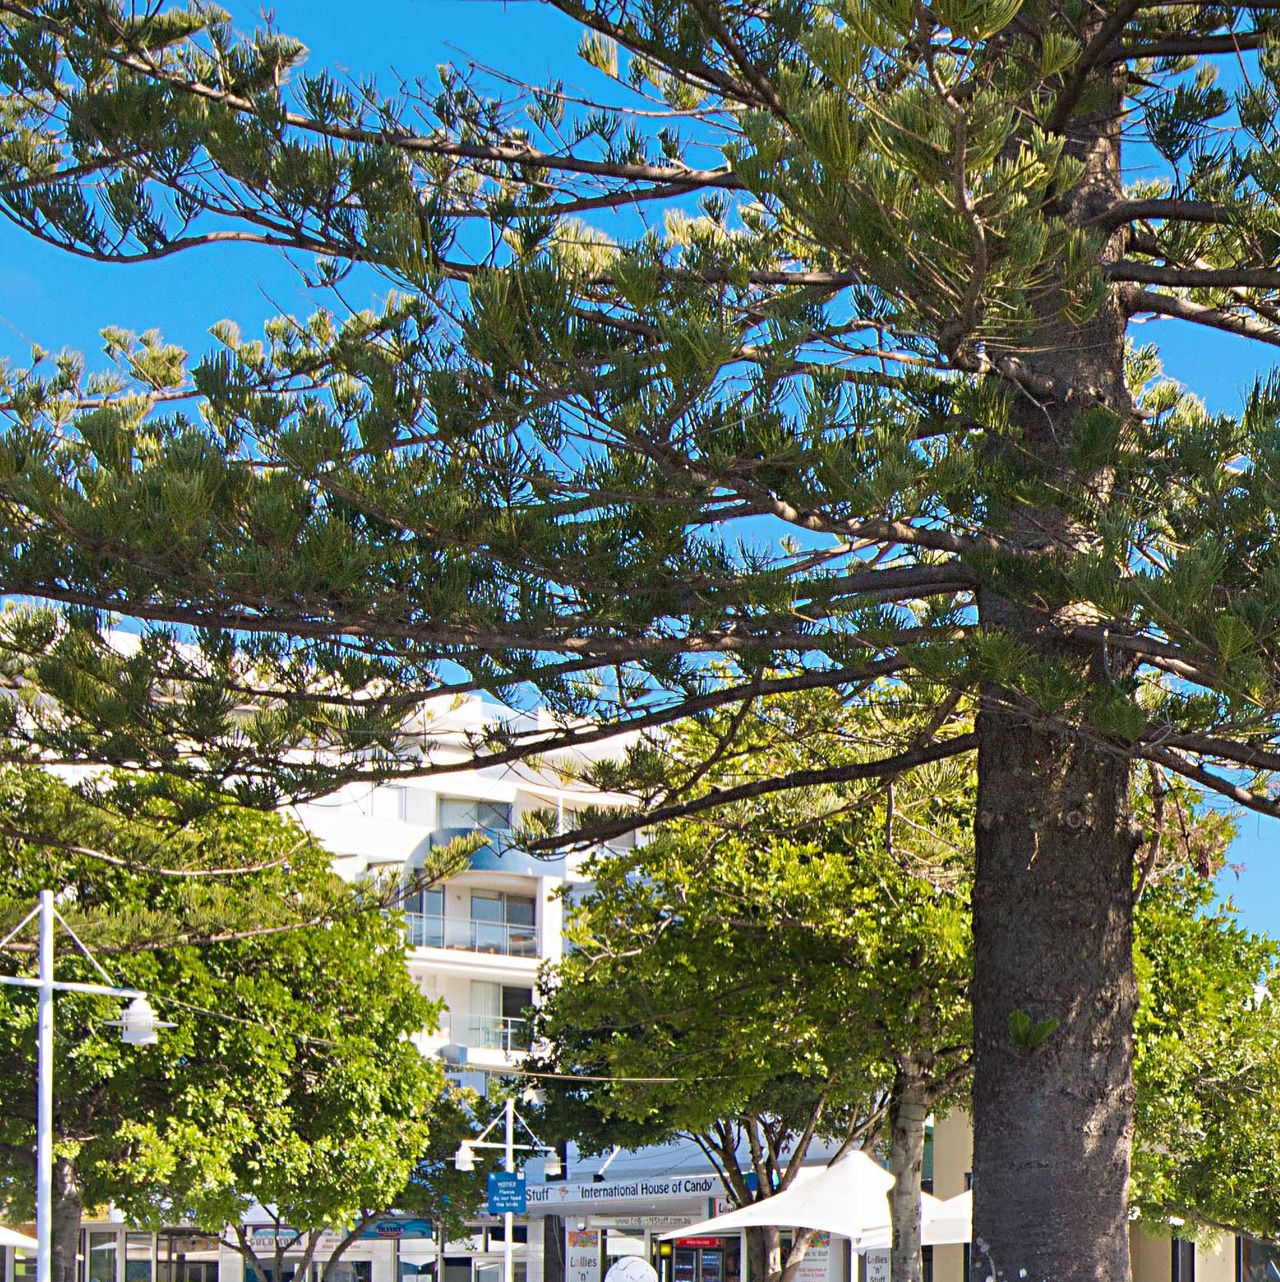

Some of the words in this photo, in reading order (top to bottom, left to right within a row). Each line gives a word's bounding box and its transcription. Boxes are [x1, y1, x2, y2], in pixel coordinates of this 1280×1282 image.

[526, 1188, 550, 1202] Stuff
[641, 1182, 672, 1195] House
[672, 1180, 681, 1193] of
[570, 1256, 598, 1268] Lollies
